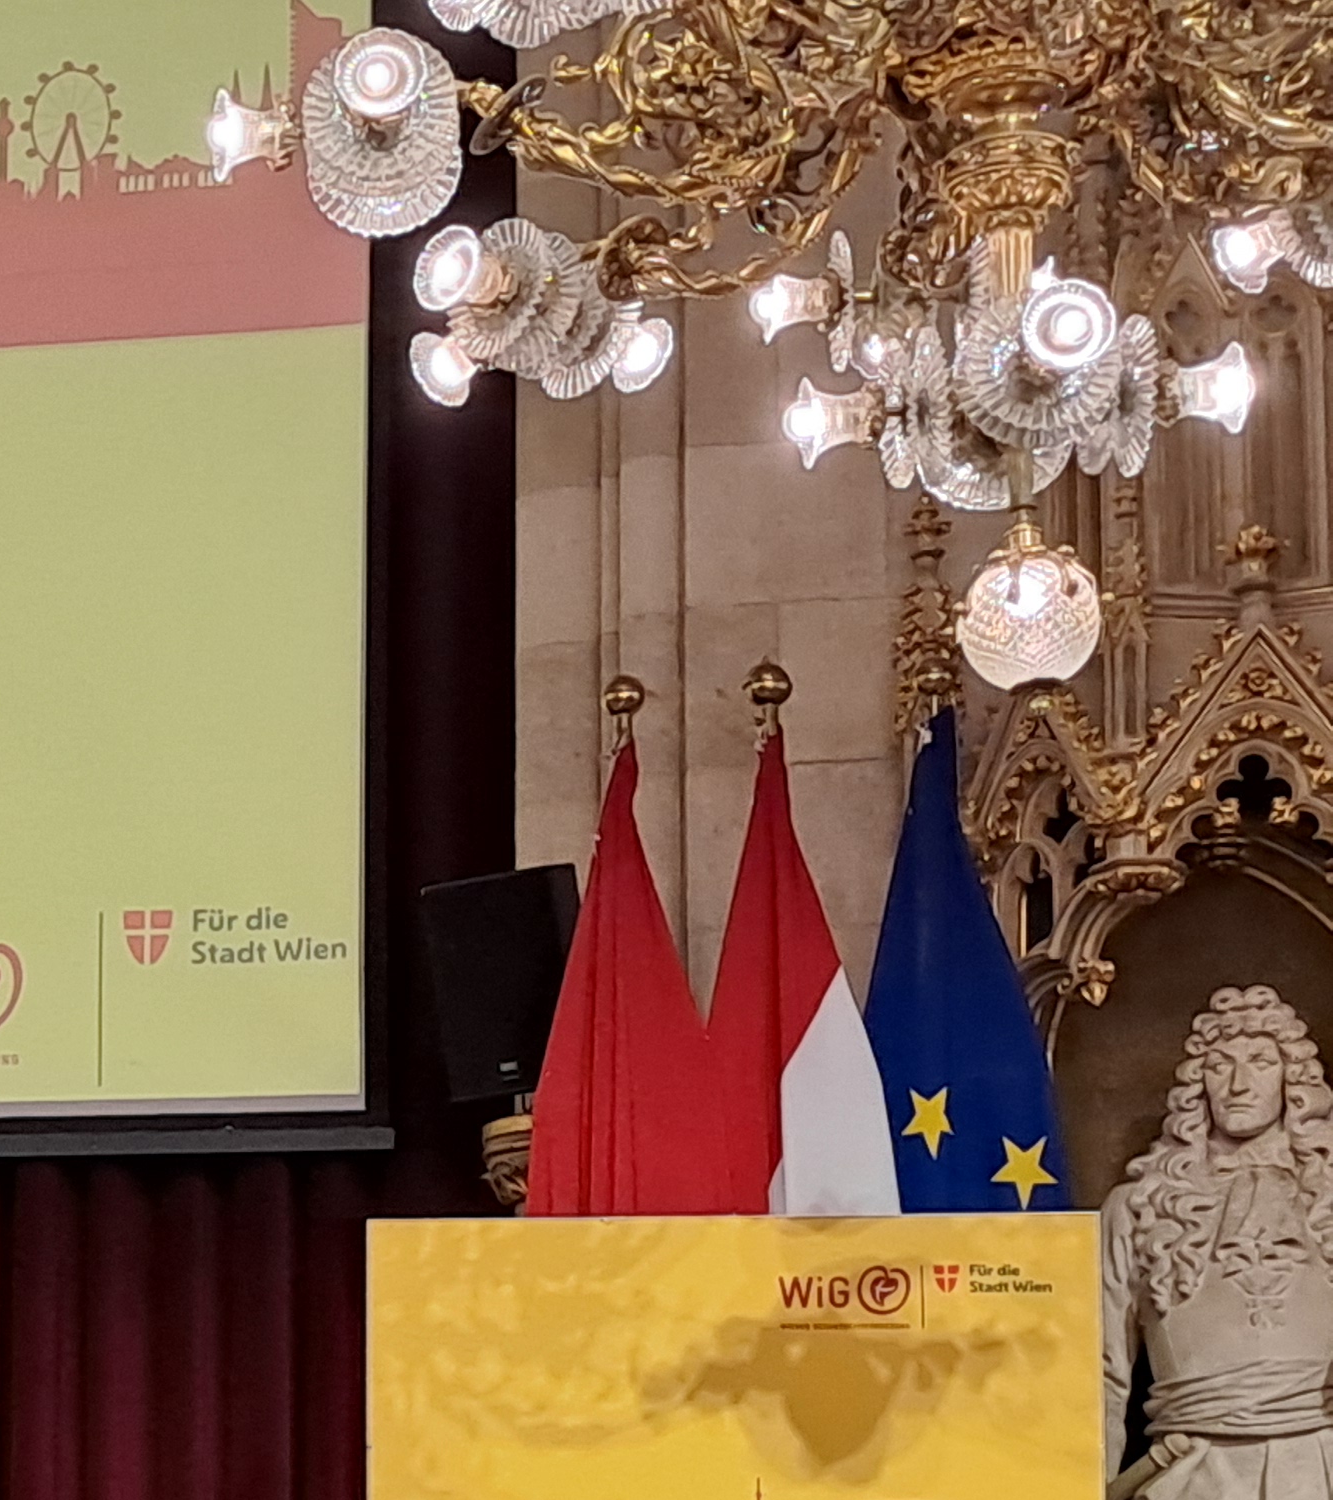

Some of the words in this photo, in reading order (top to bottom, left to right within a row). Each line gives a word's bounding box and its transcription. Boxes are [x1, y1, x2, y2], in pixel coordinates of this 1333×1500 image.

[192, 908, 239, 932] Für
[245, 906, 289, 931] die
[191, 940, 267, 965] Stadt
[273, 937, 347, 962] Wien
[969, 1264, 994, 1277] Für
[997, 1264, 1021, 1277] die
[779, 1276, 850, 1309] WiG
[969, 1280, 1010, 1294] Stadt
[1013, 1279, 1053, 1294] Wien
